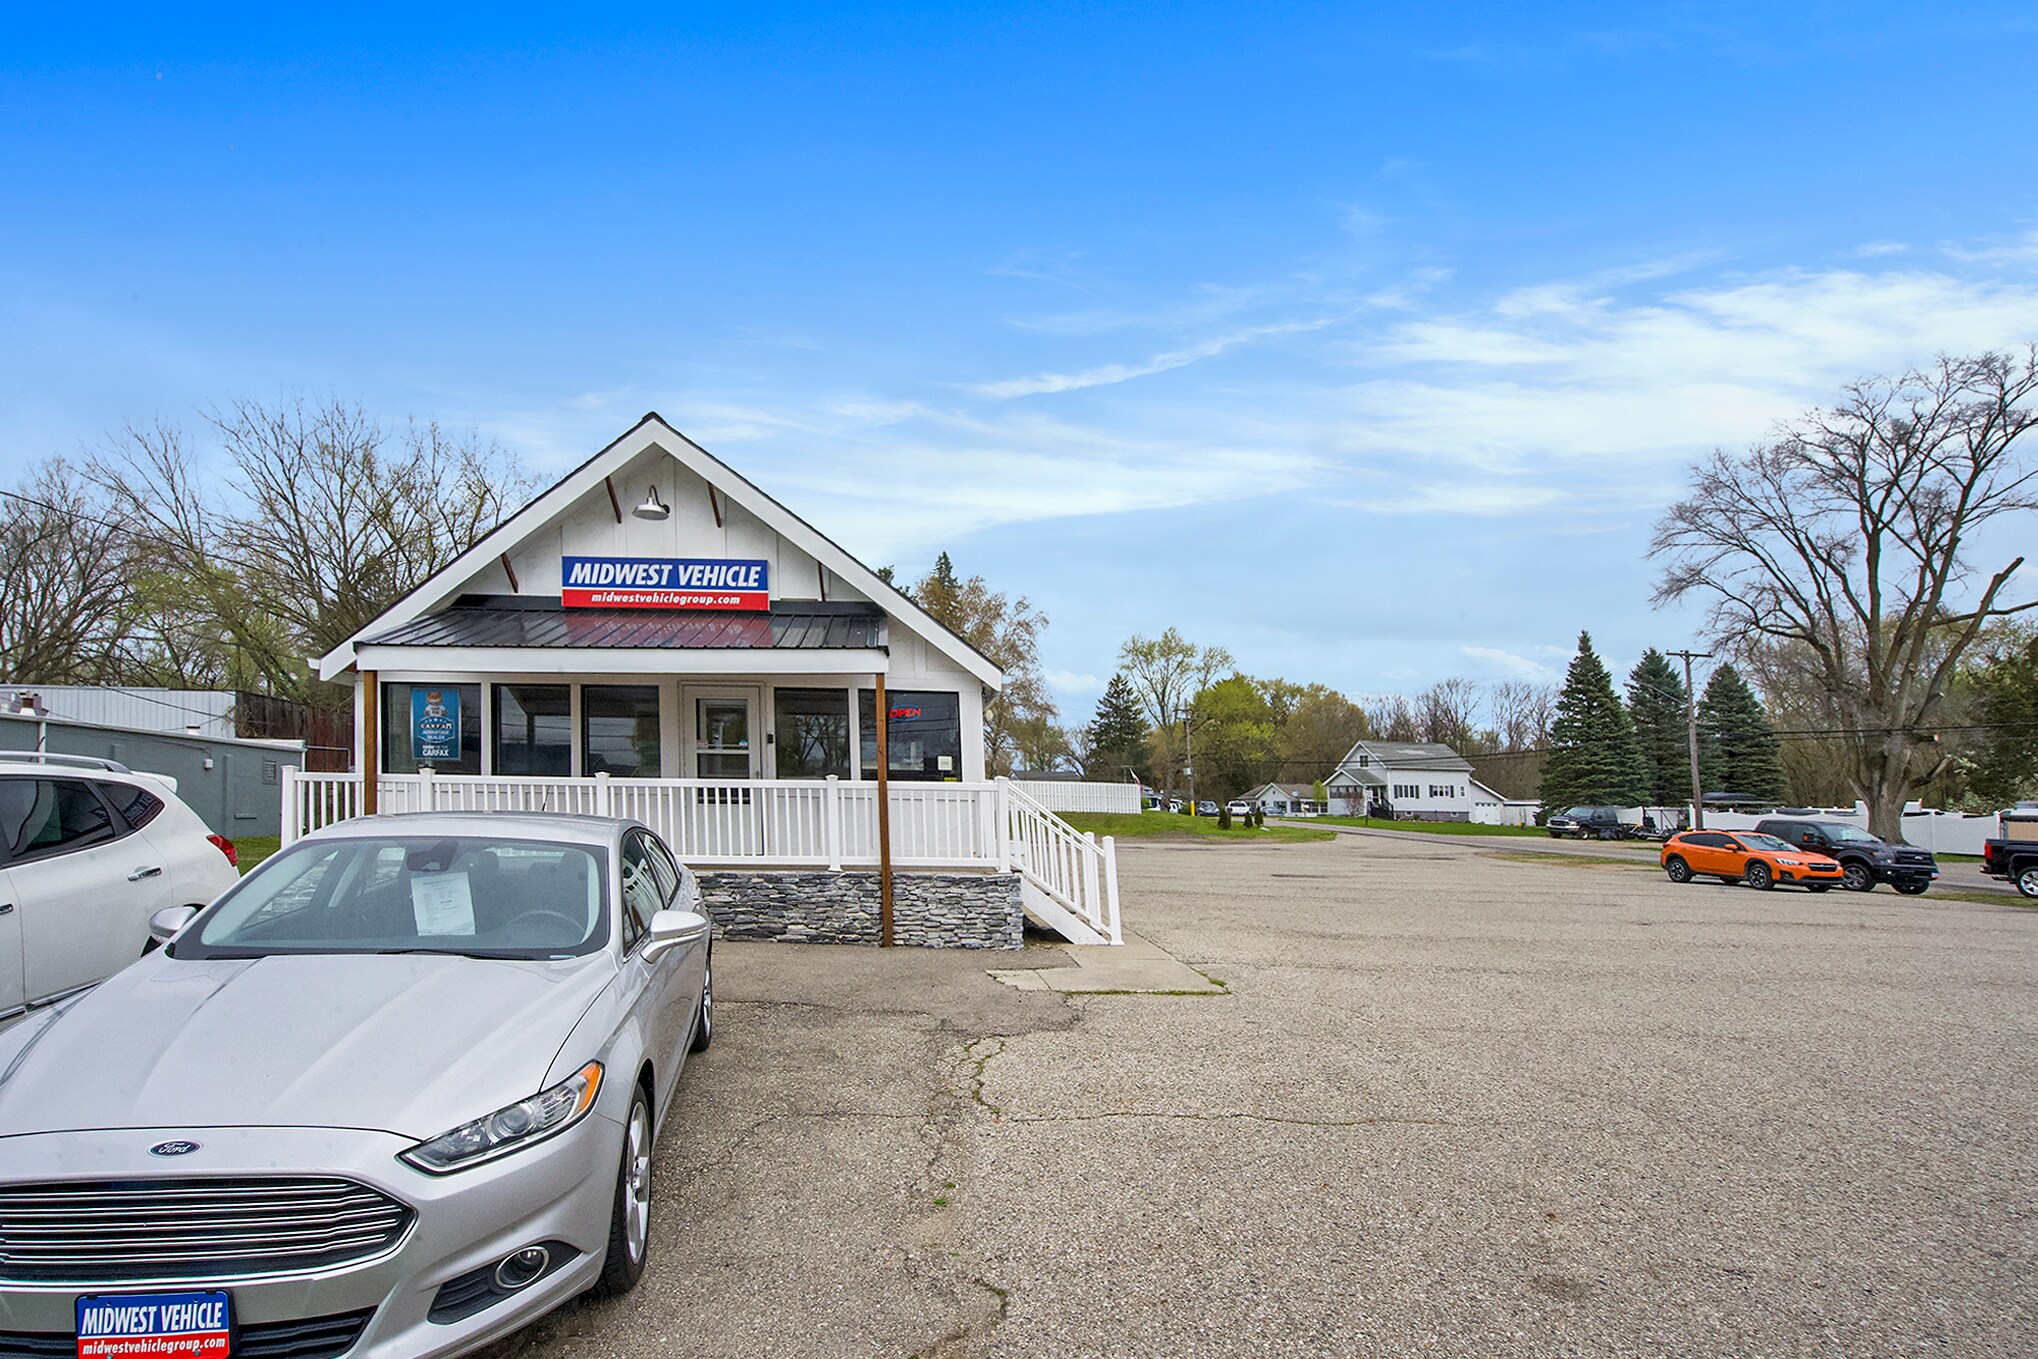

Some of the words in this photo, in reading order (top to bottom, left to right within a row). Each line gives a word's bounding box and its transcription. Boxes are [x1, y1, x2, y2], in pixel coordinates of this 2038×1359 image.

[569, 562, 674, 586] MIDWEST
[678, 564, 762, 588] VEHICLE
[591, 591, 741, 606] midwestvehiclegroup.com
[889, 708, 922, 718] OPEN
[158, 1142, 191, 1154] Ford
[81, 1305, 158, 1335] MIDWEST
[161, 1301, 224, 1332] VEHICLE
[82, 1337, 226, 1356] midwestvehiclegroup.com
